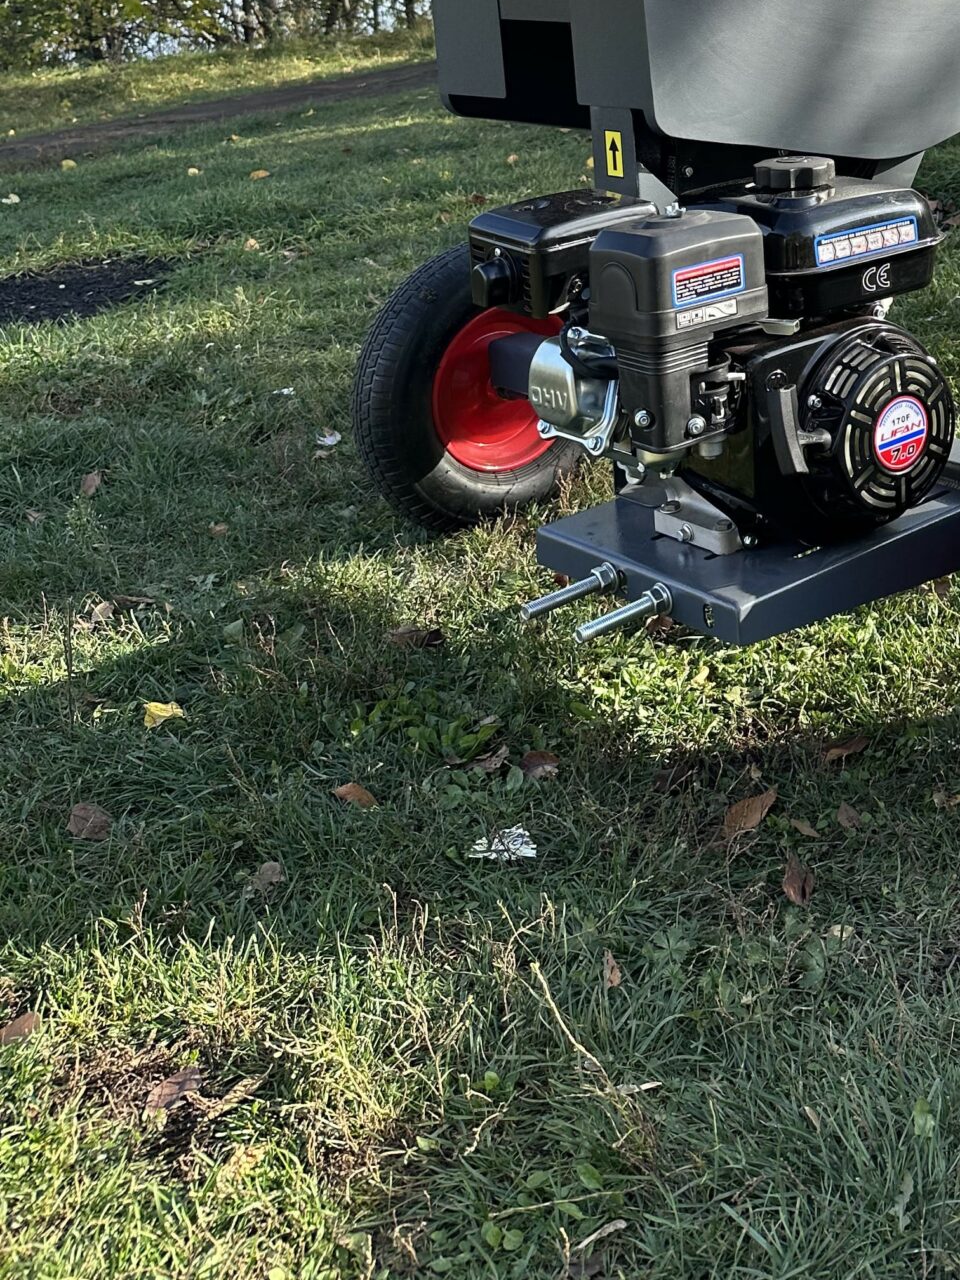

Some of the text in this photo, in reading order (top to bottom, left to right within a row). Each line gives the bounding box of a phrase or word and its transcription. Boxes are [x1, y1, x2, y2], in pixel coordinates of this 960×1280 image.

[862, 263, 890, 291] CE
[531, 385, 568, 411] OHV
[880, 419, 922, 442] LIFAN
[890, 443, 916, 464] 7.0
